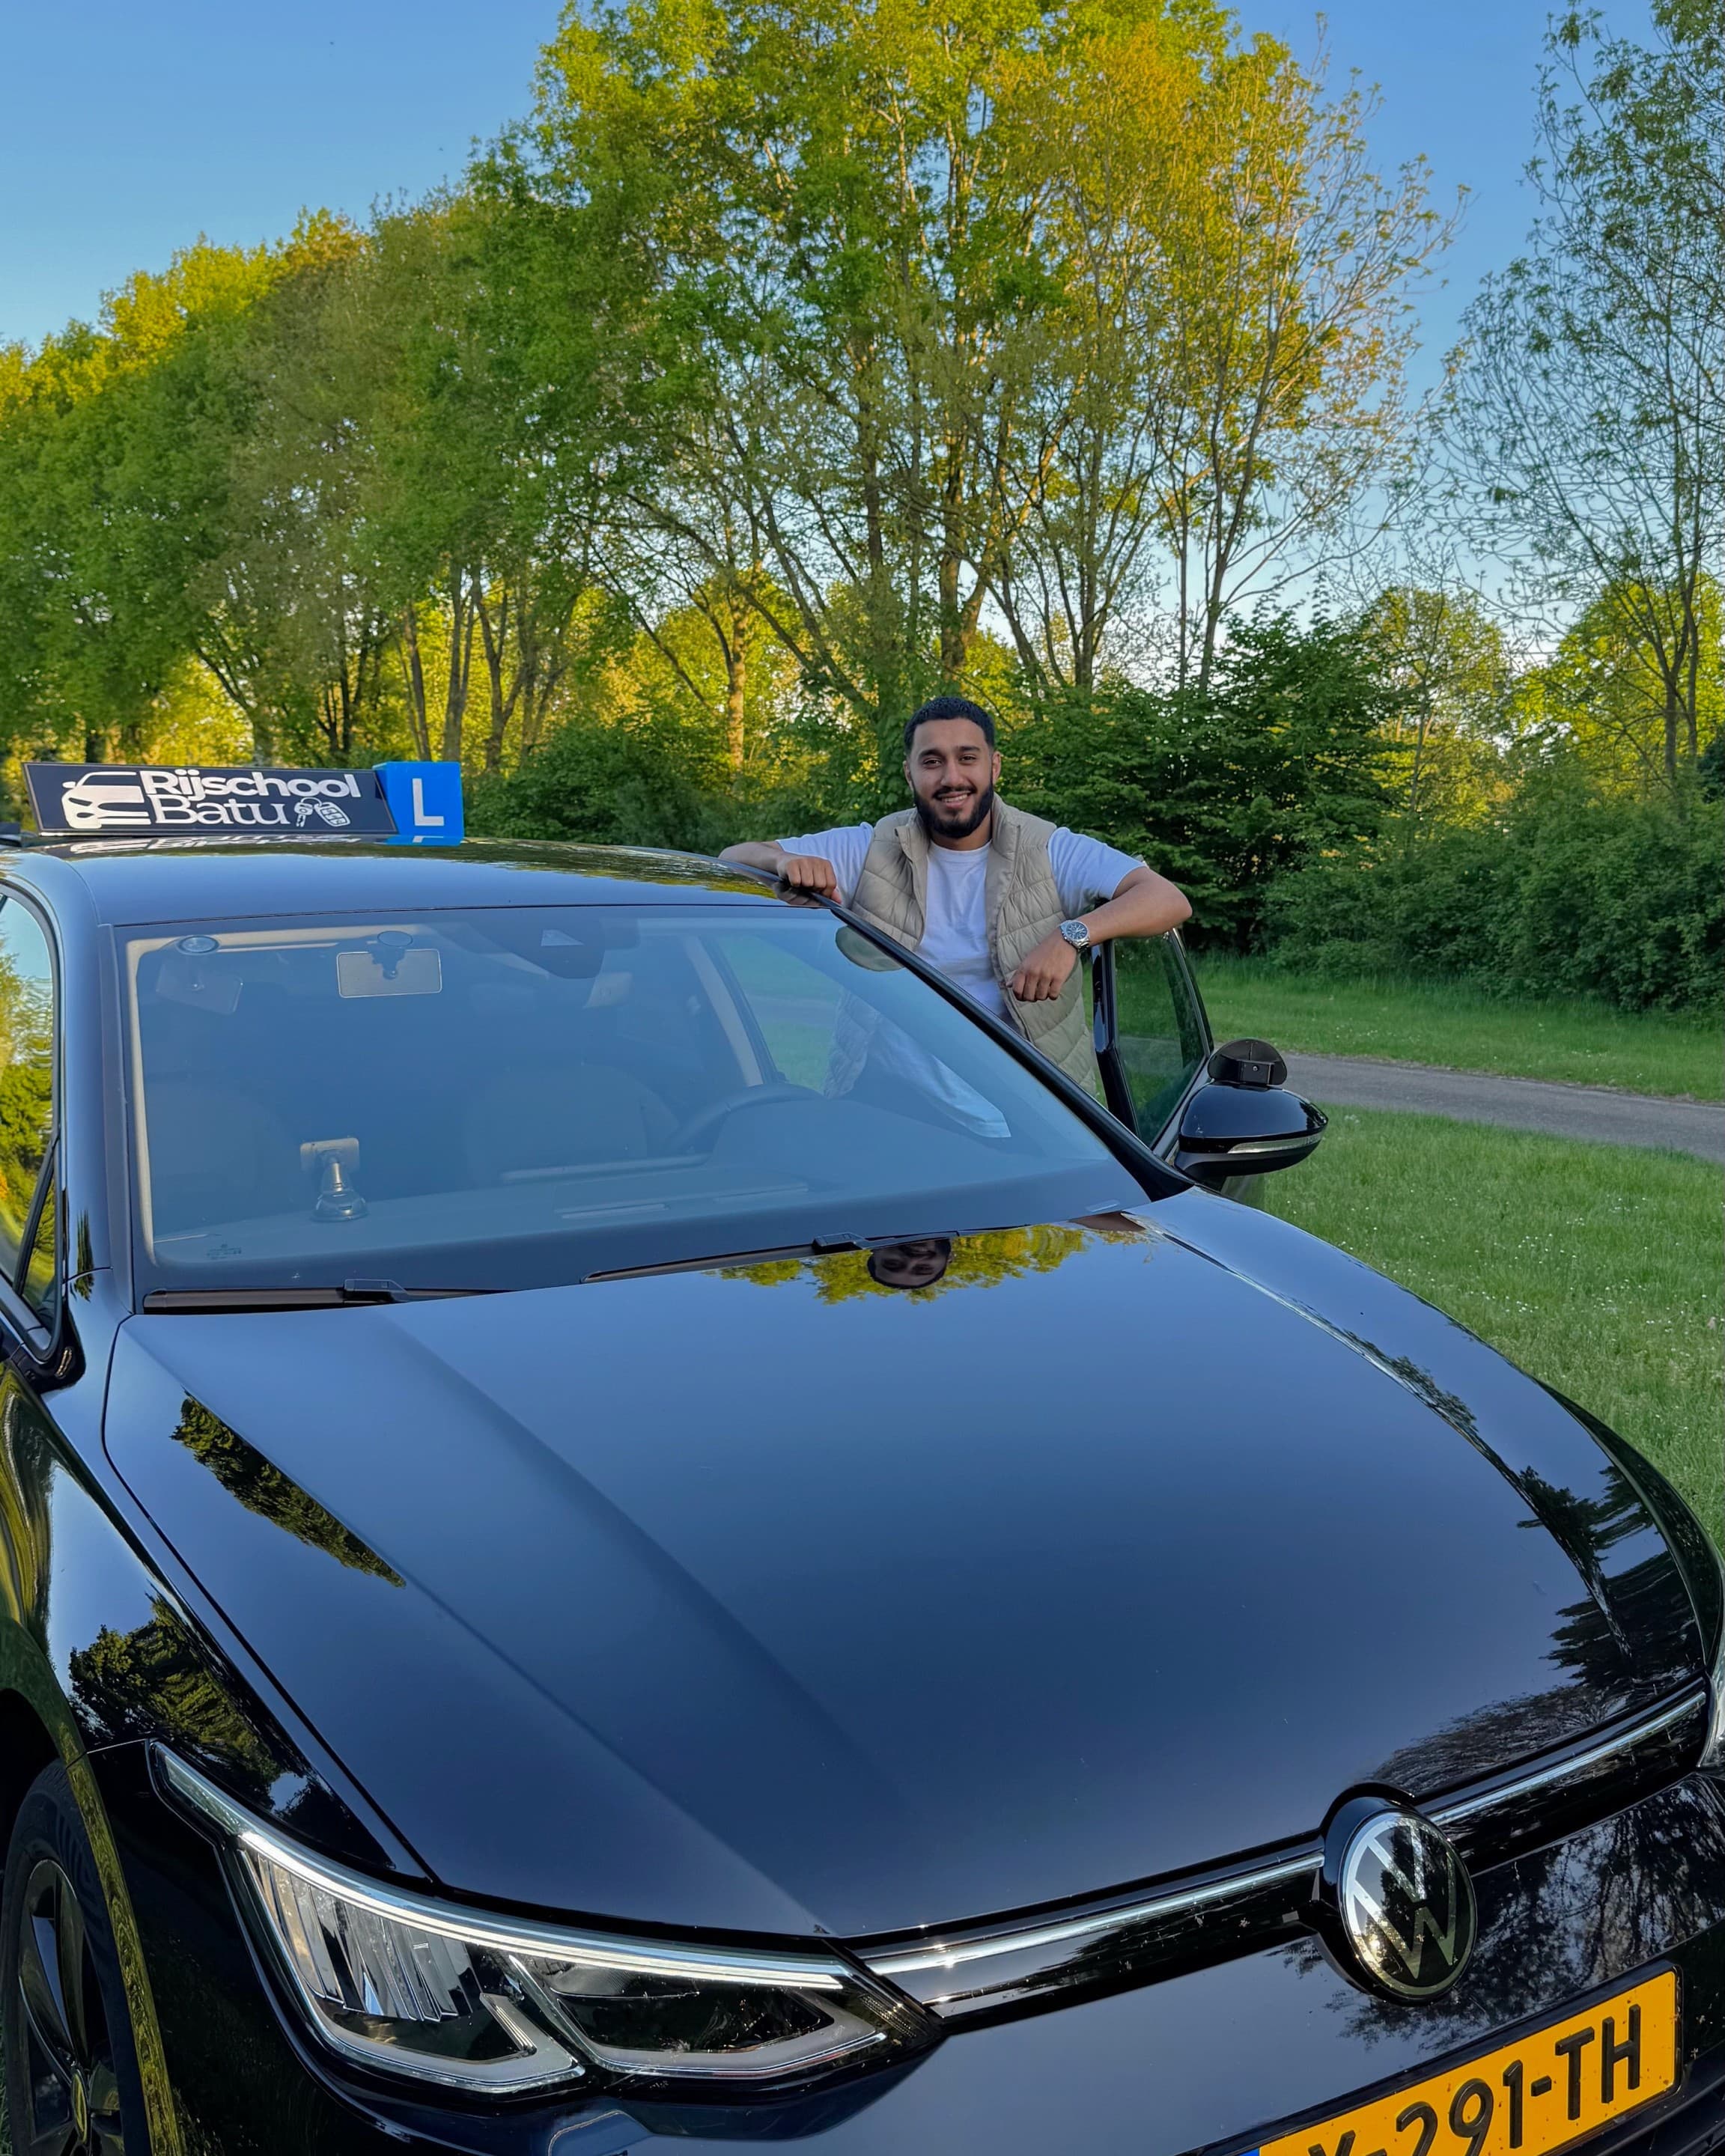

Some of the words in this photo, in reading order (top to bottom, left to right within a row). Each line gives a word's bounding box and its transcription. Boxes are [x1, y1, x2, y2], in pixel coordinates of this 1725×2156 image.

[140, 769, 361, 801] Rijschool
[413, 778, 444, 826] L
[147, 794, 290, 825] Batu
[1308, 2004, 1641, 2156] 291-TH
